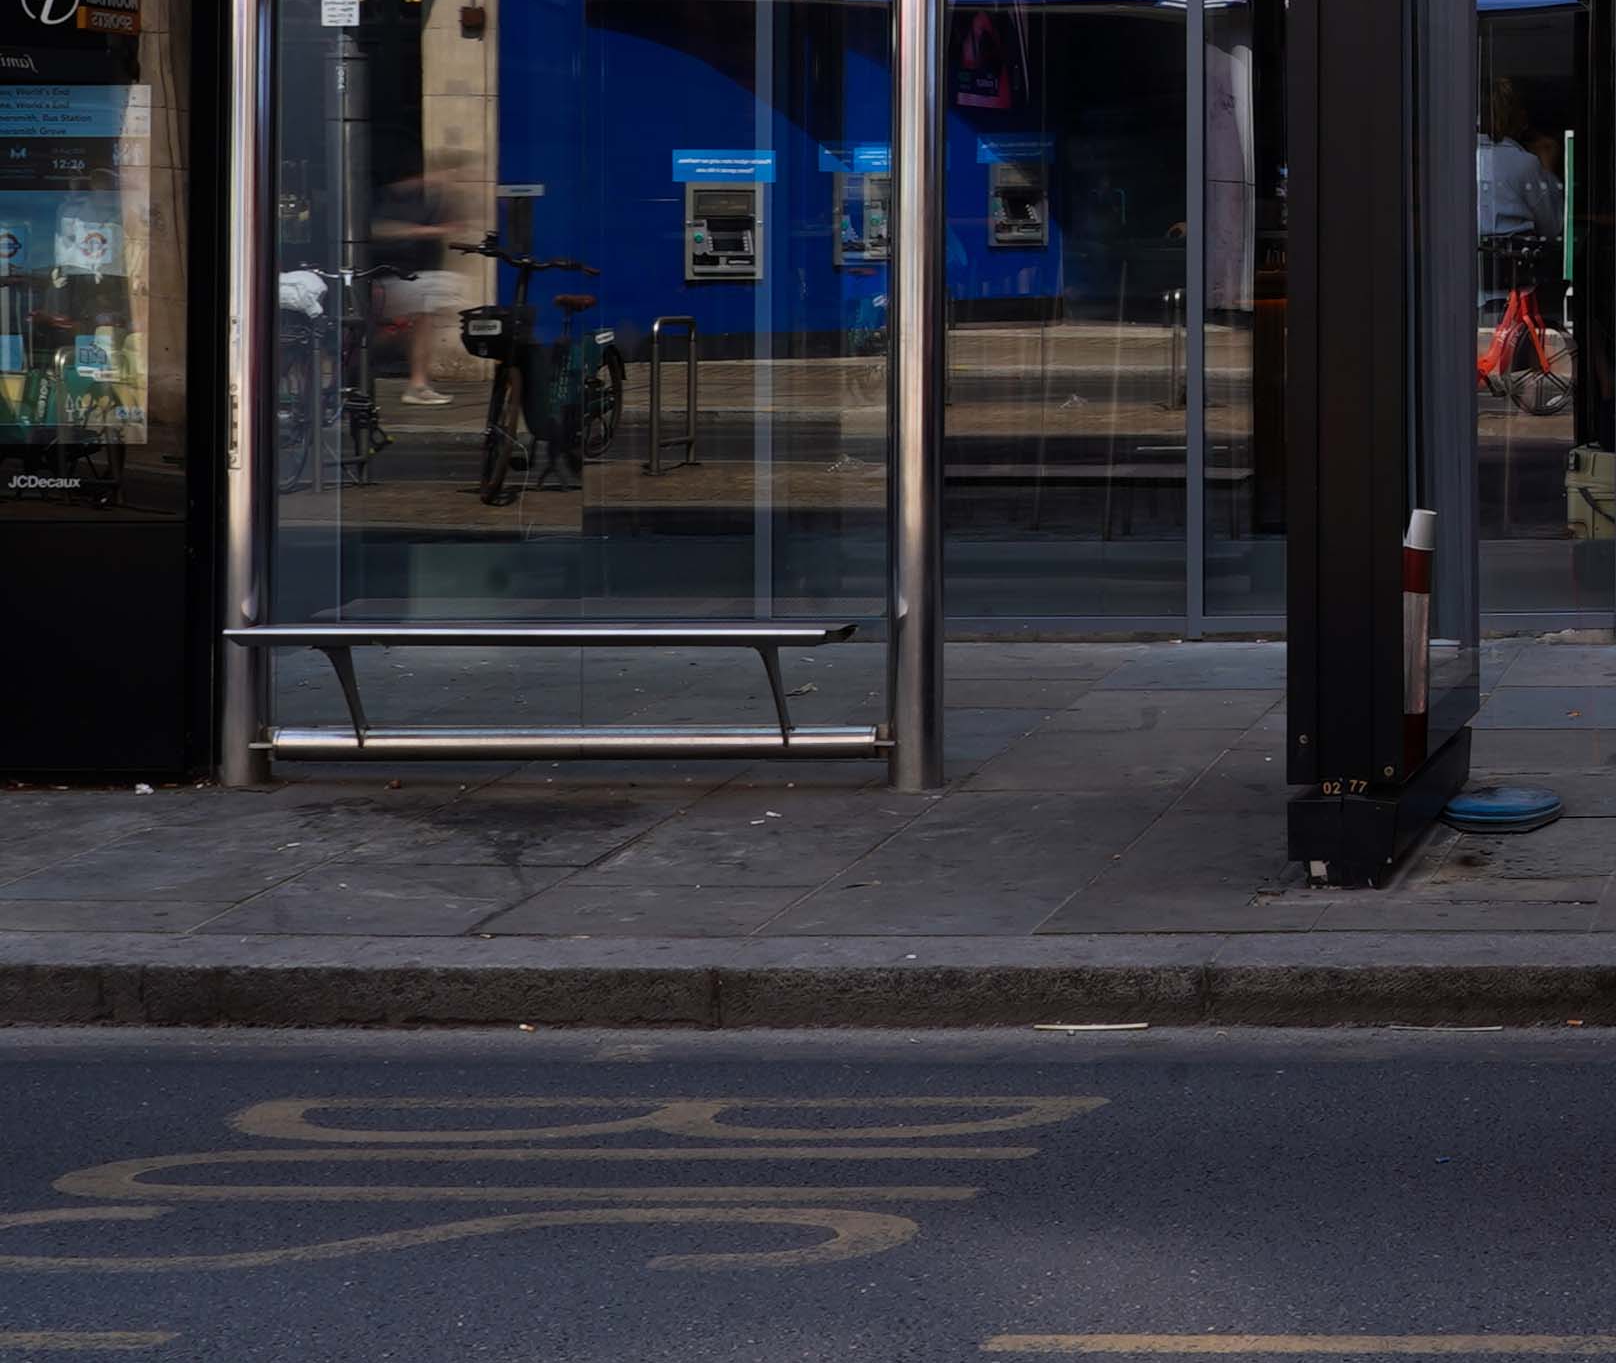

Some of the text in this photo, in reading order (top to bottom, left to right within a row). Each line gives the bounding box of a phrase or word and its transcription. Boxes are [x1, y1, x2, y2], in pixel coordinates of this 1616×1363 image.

[8, 475, 81, 488] JCDecaux
[1322, 778, 1368, 796] 02 77
